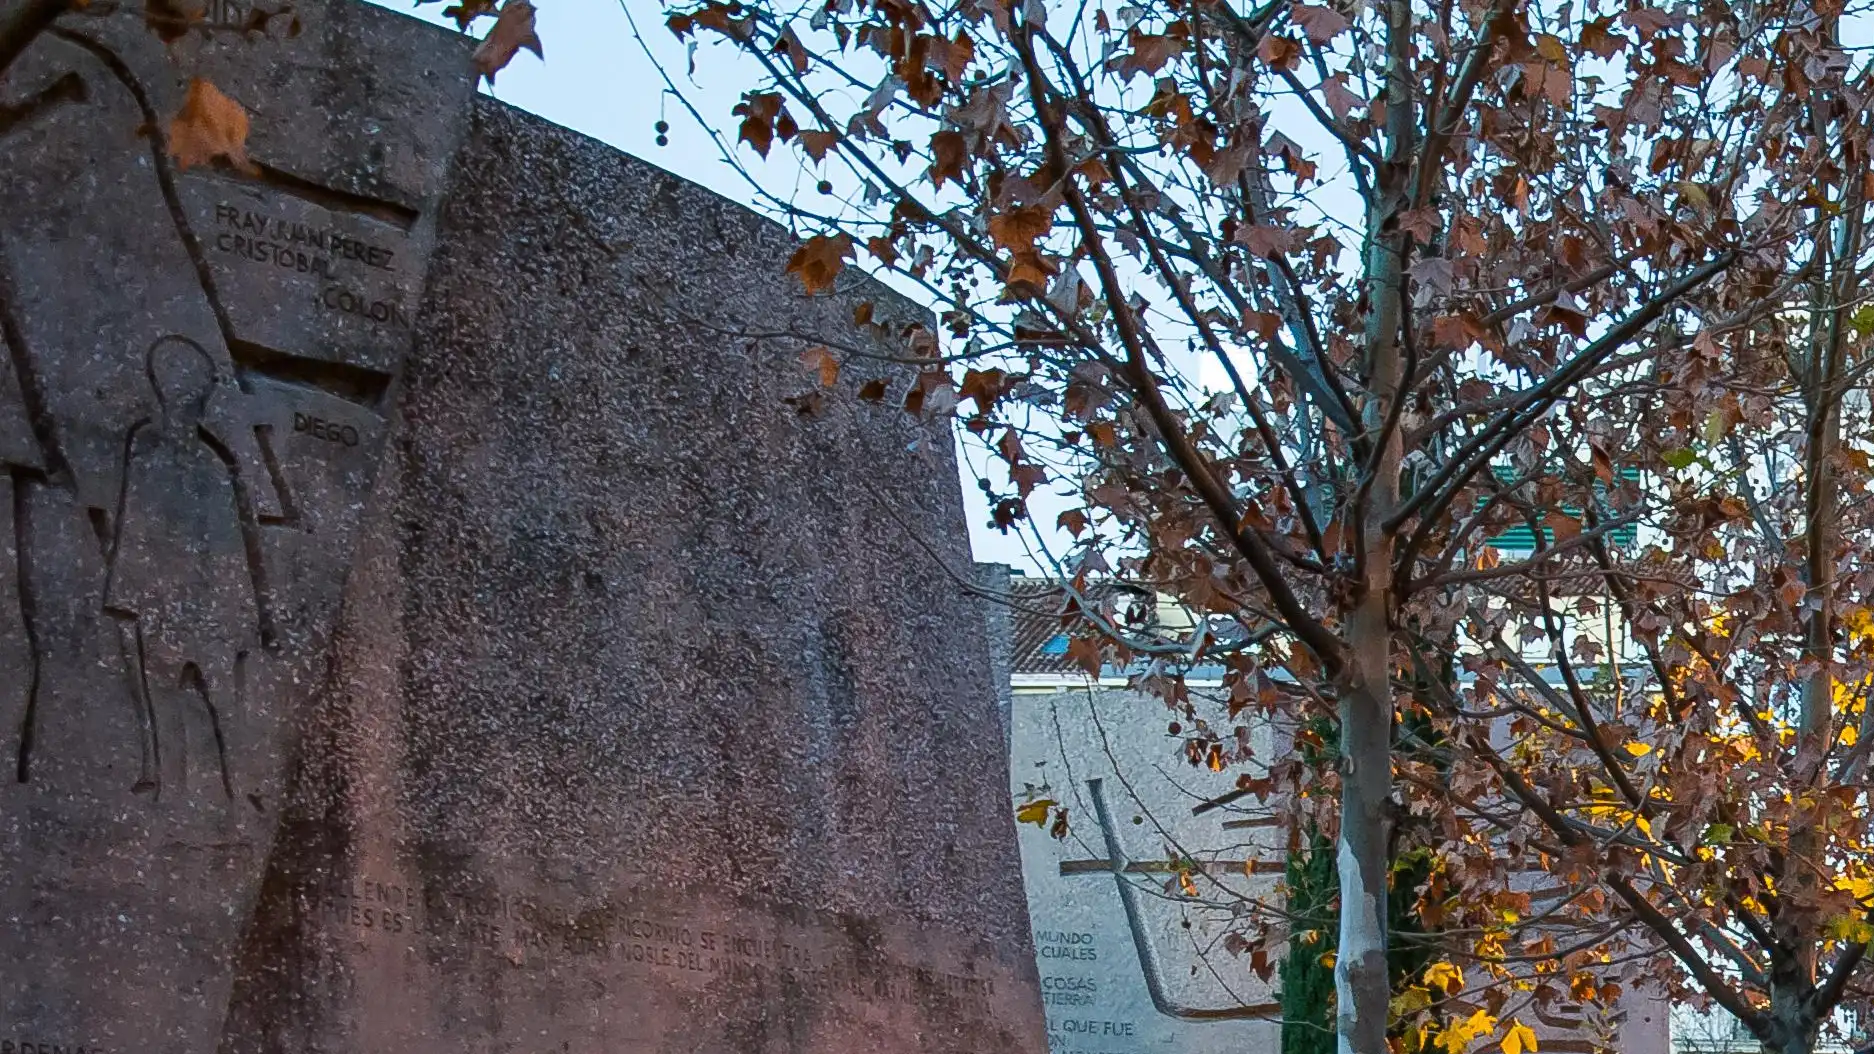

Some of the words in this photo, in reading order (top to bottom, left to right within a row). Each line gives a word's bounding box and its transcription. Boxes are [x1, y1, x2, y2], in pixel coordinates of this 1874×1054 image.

[216, 205, 267, 234] FRAY
[330, 234, 396, 272] PEREZ
[216, 233, 336, 281] CRISTOBAL
[323, 286, 410, 329] COLON
[293, 411, 360, 449] DIEGO
[1035, 930, 1094, 946] MUNDO
[1041, 946, 1098, 961] CUALES
[1043, 976, 1098, 992] COSAS
[1044, 992, 1096, 1007] TIERRA
[1063, 1019, 1100, 1034] QUE
[1103, 1021, 1136, 1036] FUE
